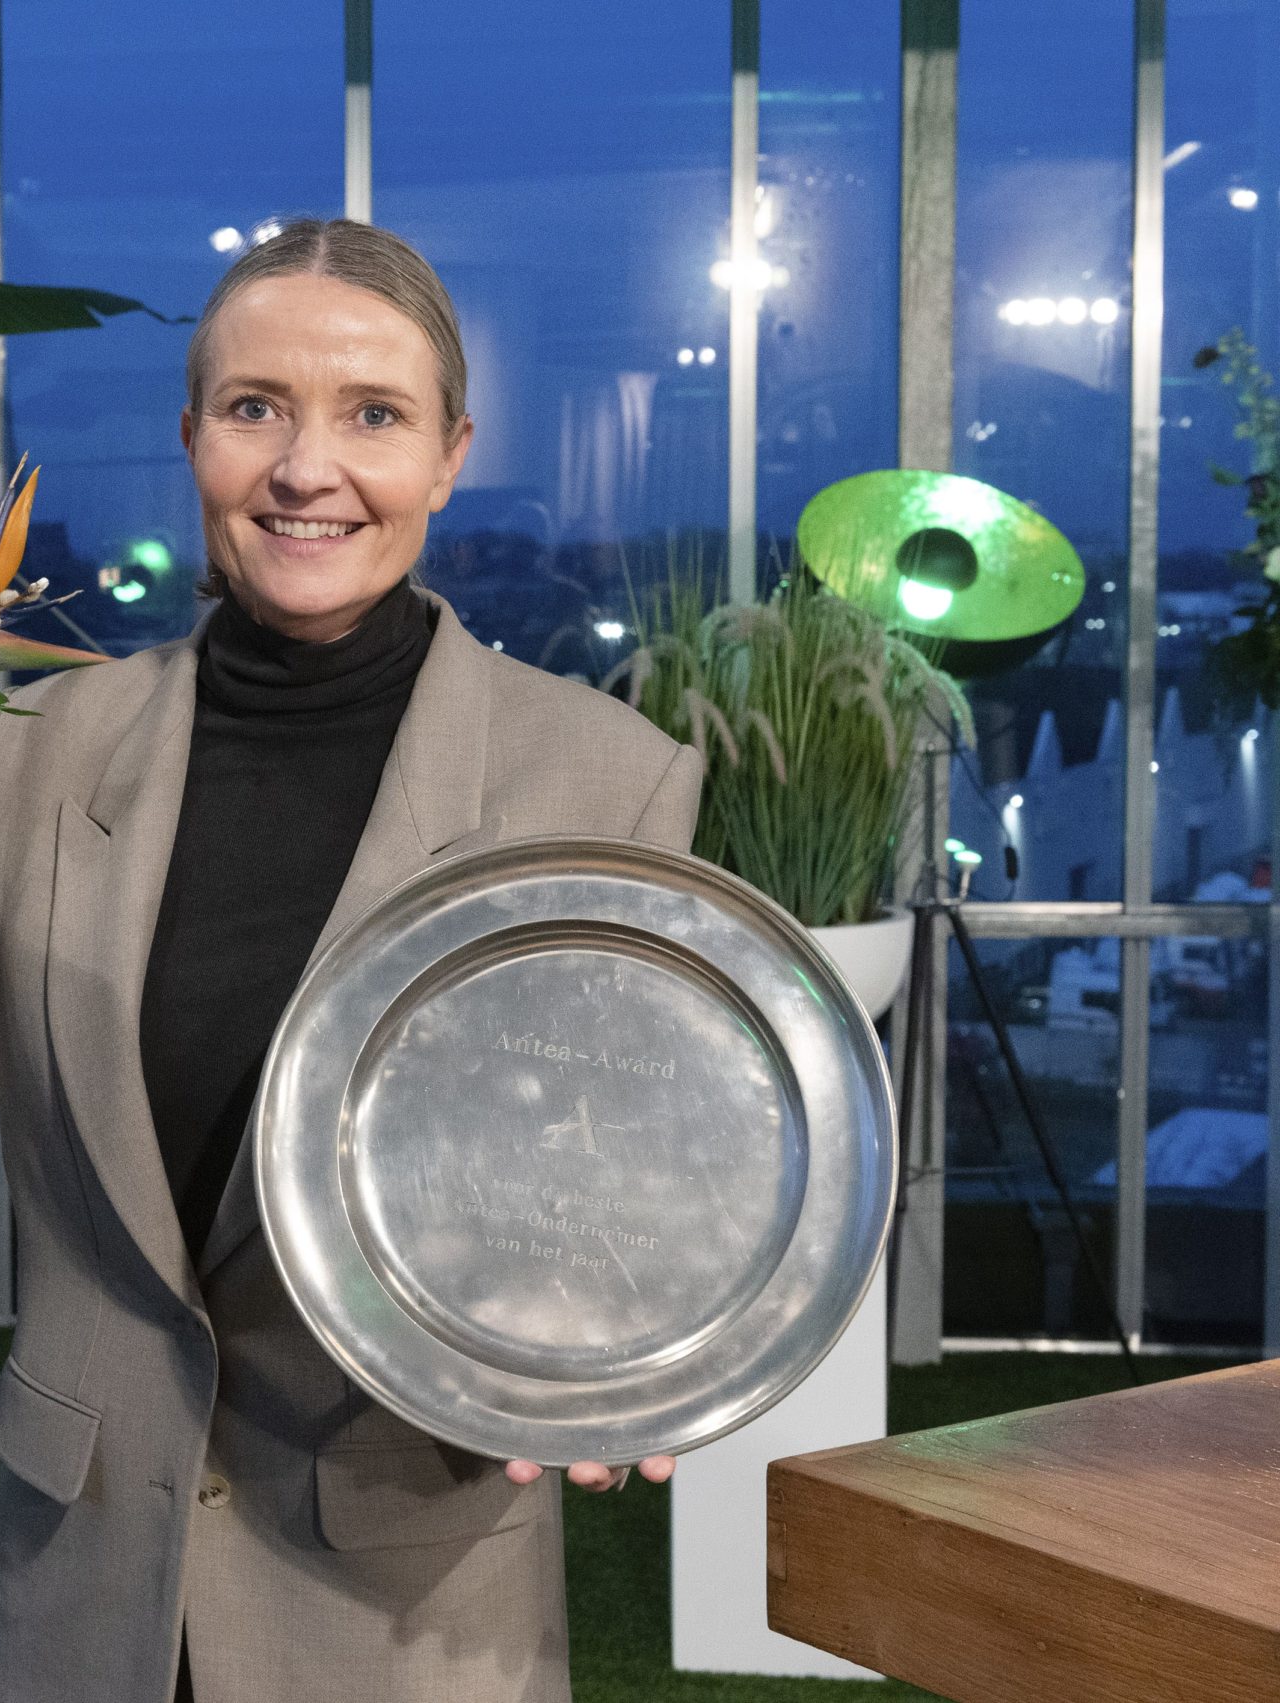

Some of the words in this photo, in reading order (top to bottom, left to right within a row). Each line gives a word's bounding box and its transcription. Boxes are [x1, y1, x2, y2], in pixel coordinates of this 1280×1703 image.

[493, 1030, 677, 1081] Antea-Award
[485, 1234, 521, 1253] van
[528, 1239, 564, 1261] het
[570, 1251, 610, 1270] jaar
